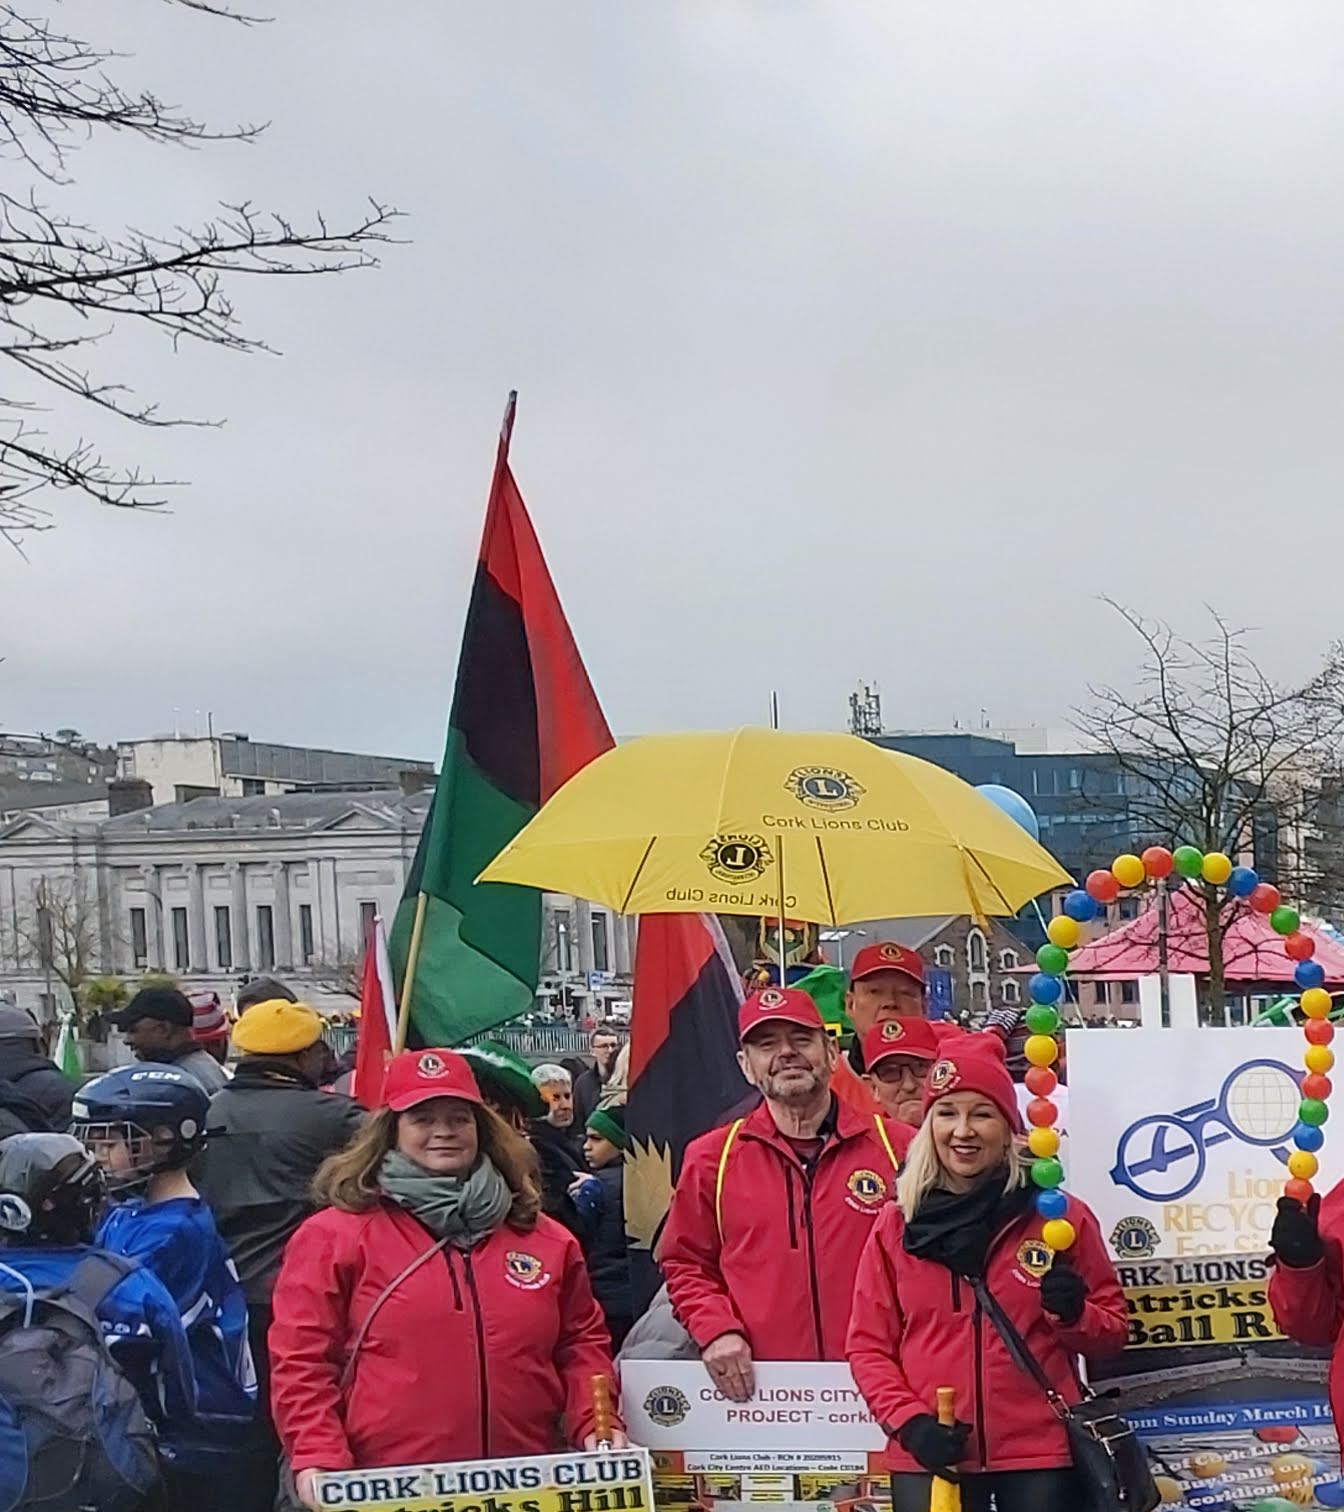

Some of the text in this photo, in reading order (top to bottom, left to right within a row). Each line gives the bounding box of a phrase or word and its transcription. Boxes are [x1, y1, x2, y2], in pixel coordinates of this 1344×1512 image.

[763, 815, 909, 831] Cork Lions Club
[1176, 1259, 1267, 1285] LIONS
[759, 1389, 862, 1402] LIONS CITY
[727, 1410, 813, 1423] PROJECT
[322, 1459, 641, 1504] CORK LIONS CLUB
